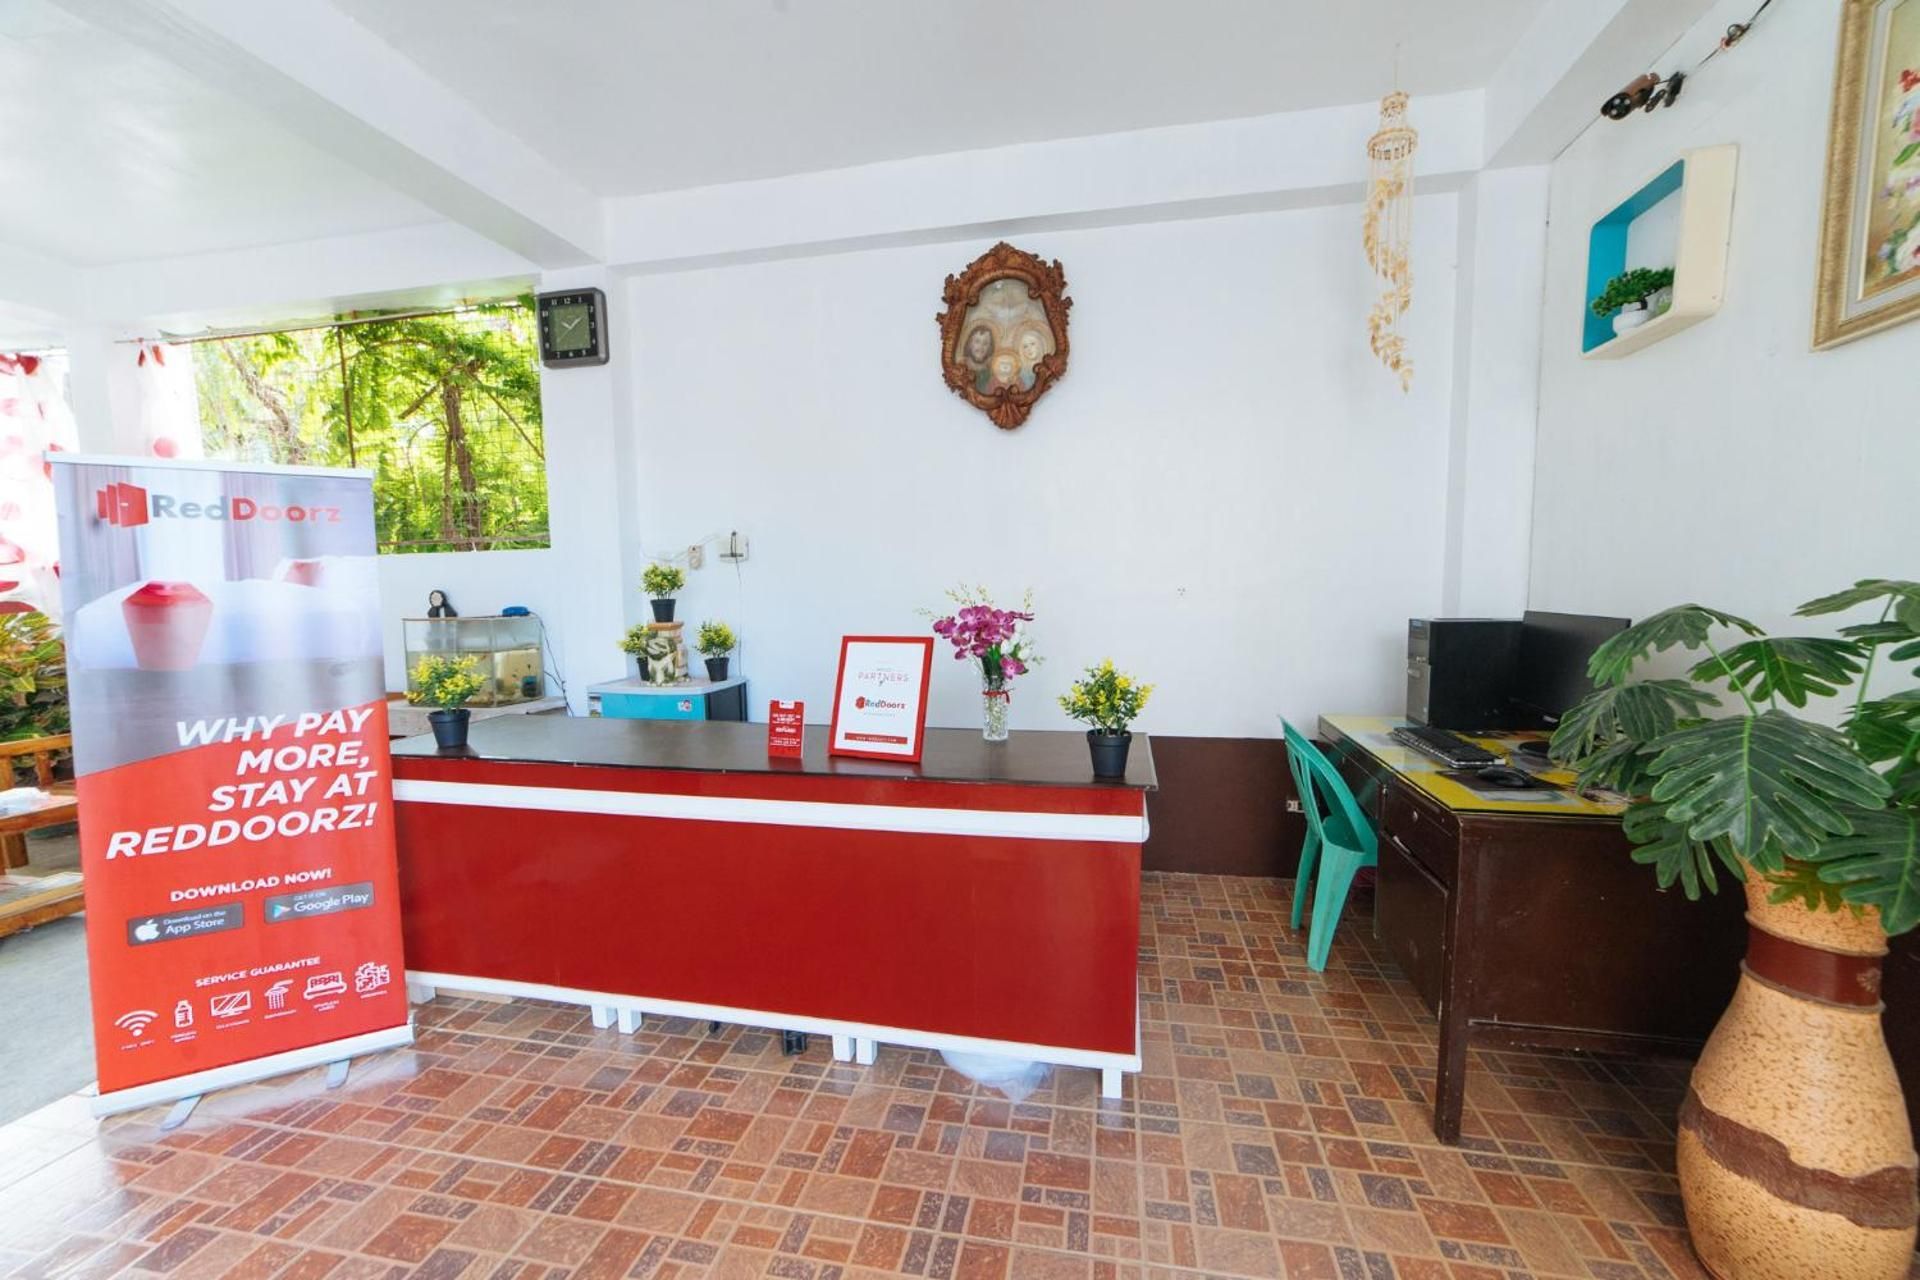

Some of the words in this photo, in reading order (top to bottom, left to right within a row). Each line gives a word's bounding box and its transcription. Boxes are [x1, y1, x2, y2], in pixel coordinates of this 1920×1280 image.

[151, 493, 341, 522] RedDoorz
[176, 714, 286, 746] WHY
[294, 708, 373, 737] PAY
[236, 741, 369, 776] MORE,
[208, 777, 316, 812] STAY
[323, 771, 378, 799] AT
[105, 802, 378, 860] REDDOORZ!
[170, 876, 280, 902] DOWNLOAD
[284, 868, 332, 884] NOW!
[163, 913, 202, 925] Download
[293, 897, 341, 912] Google
[342, 894, 369, 905] Play
[165, 924, 191, 935] App
[193, 918, 225, 930] Store
[195, 970, 248, 988] SERVICE
[250, 956, 321, 977] GUARANTEE
